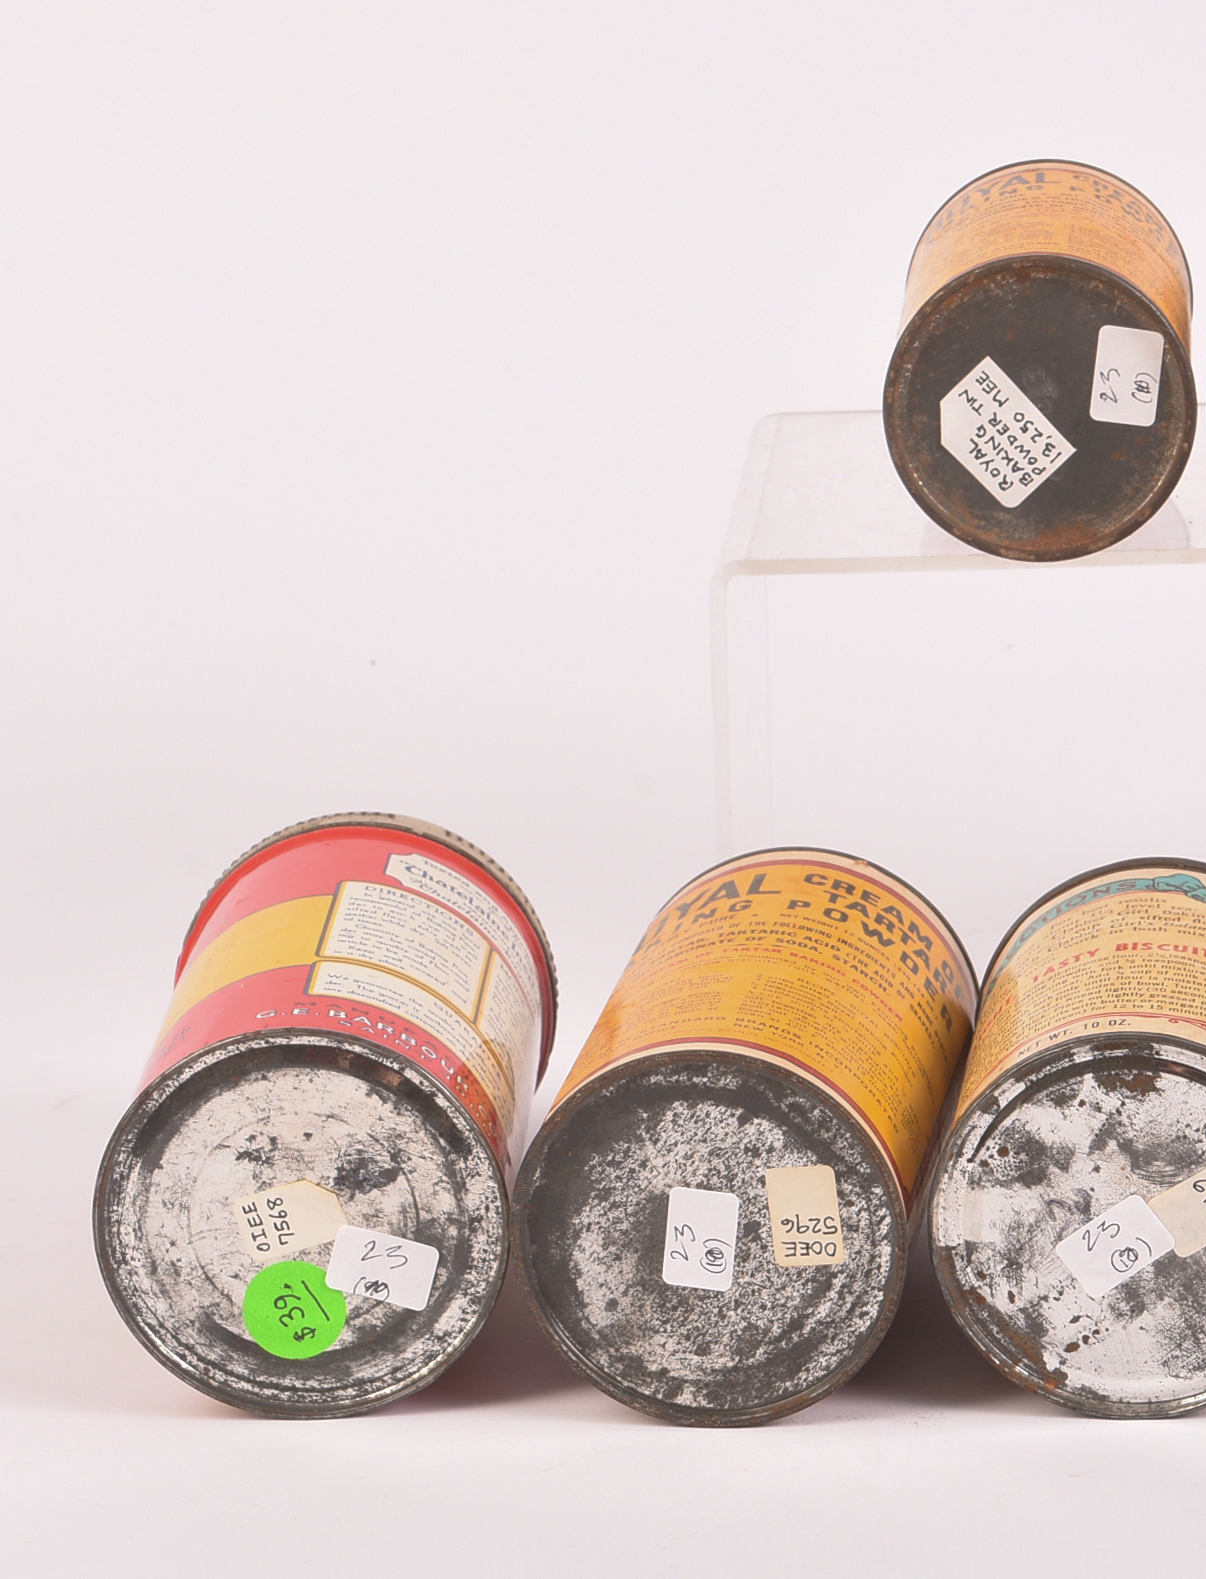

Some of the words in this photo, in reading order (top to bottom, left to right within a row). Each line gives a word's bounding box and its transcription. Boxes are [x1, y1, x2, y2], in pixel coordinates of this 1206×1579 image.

[958, 389, 983, 416] TIN
[974, 370, 1010, 408] MEE
[1099, 368, 1121, 404] 23
[975, 425, 1034, 487] BAKING
[988, 412, 1046, 476] POWDER
[968, 437, 1014, 491] ROYAL
[364, 885, 475, 938] DIRECTIONS
[803, 873, 934, 953] CREAM
[1139, 915, 1181, 923] sifted
[717, 929, 798, 938] TARTARIC
[802, 935, 842, 953] ACID
[872, 968, 895, 989] ACID
[772, 921, 833, 940] FOLLOWING
[836, 936, 897, 980] INGREDIENTS
[786, 898, 954, 1034] POWDER
[1142, 958, 1195, 968] teaspoon
[327, 973, 349, 981] We
[789, 951, 847, 978] BAKING
[851, 978, 904, 1023] POWDER
[1160, 964, 1206, 976] mixture
[1173, 971, 1198, 980] milk
[1173, 982, 1201, 993] Turn
[1105, 986, 1143, 994] lightly
[1149, 992, 1196, 1004] greased
[1017, 1041, 1041, 1058] NET
[1048, 1028, 1073, 1042] WT.
[1082, 1021, 1100, 1031] 10
[1108, 1018, 1132, 1027] OZ.
[267, 1197, 296, 1247] 7568
[780, 1214, 838, 1236] 5296
[1081, 1219, 1121, 1252] 23
[361, 1240, 409, 1269] 23
[670, 1223, 697, 1261] 23
